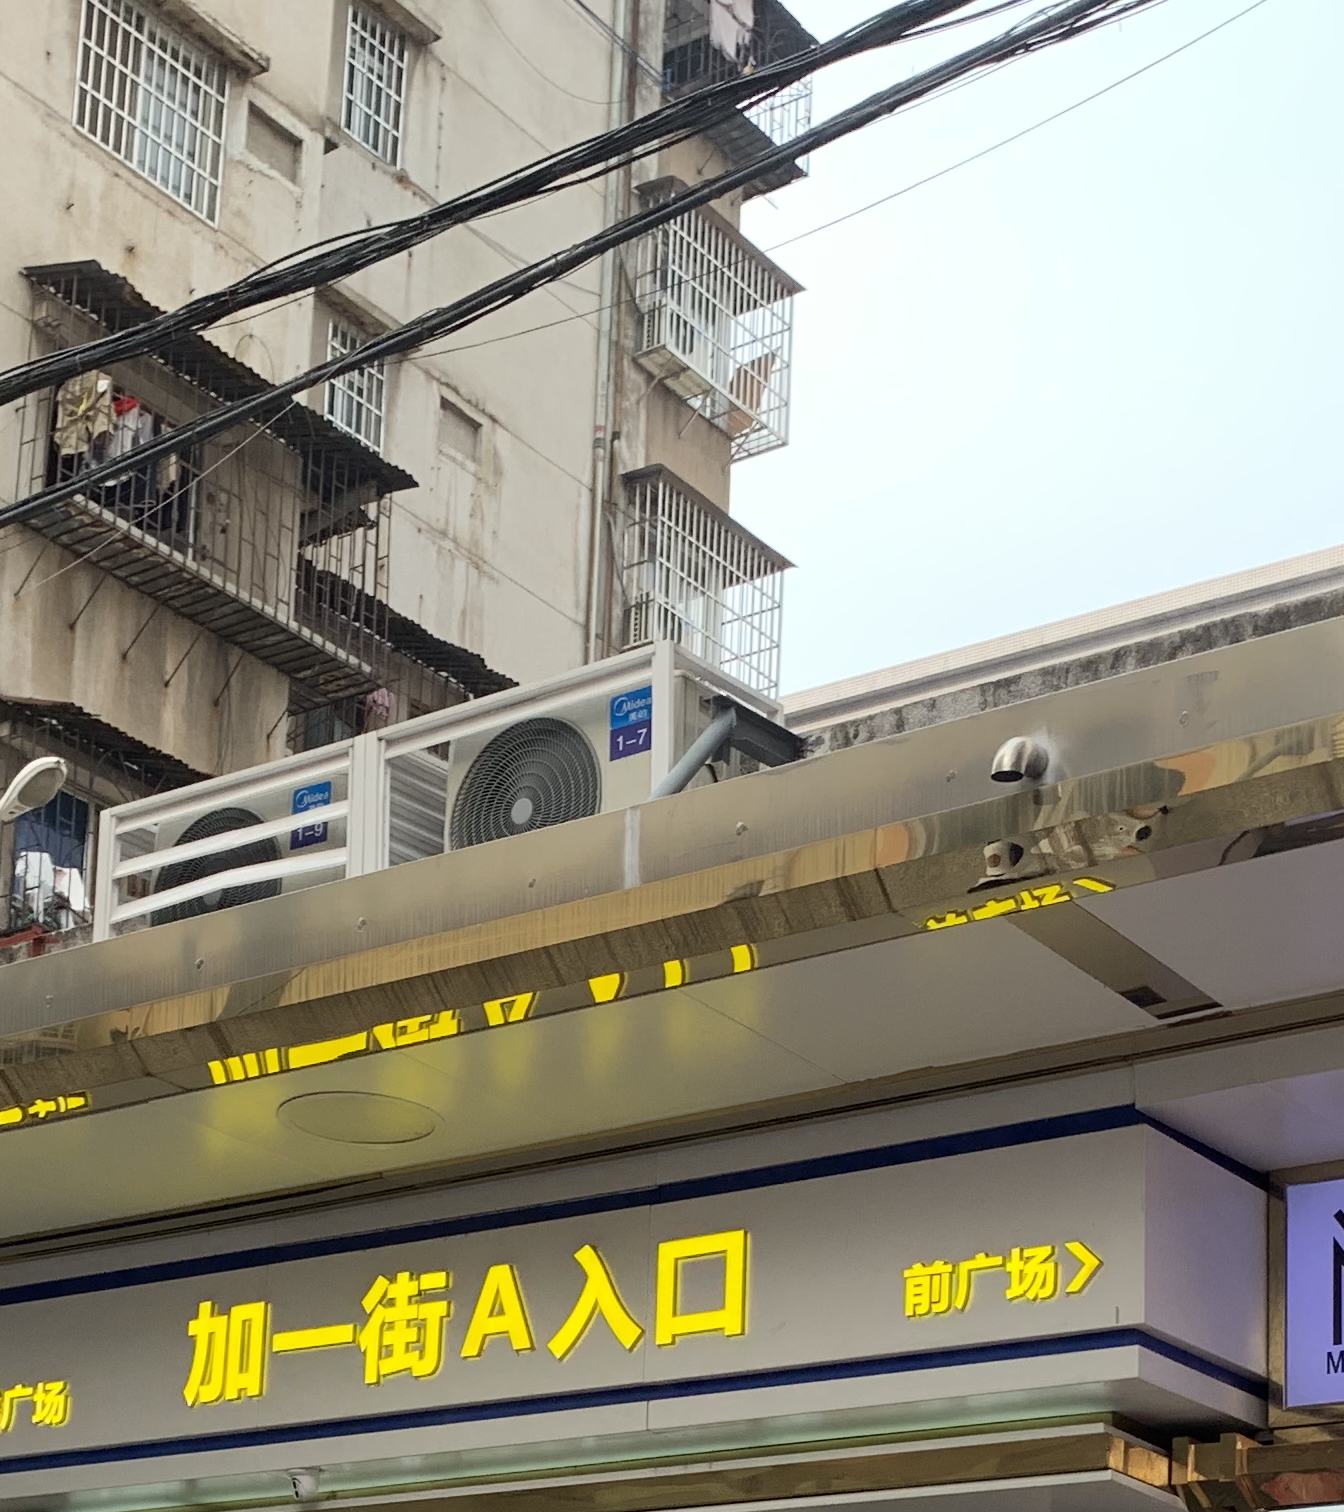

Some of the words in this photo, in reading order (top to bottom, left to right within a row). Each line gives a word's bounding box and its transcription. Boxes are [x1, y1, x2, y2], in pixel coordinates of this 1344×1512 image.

[182, 1228, 752, 1408] 加一街A入口
[902, 1247, 1058, 1317] 前广场
